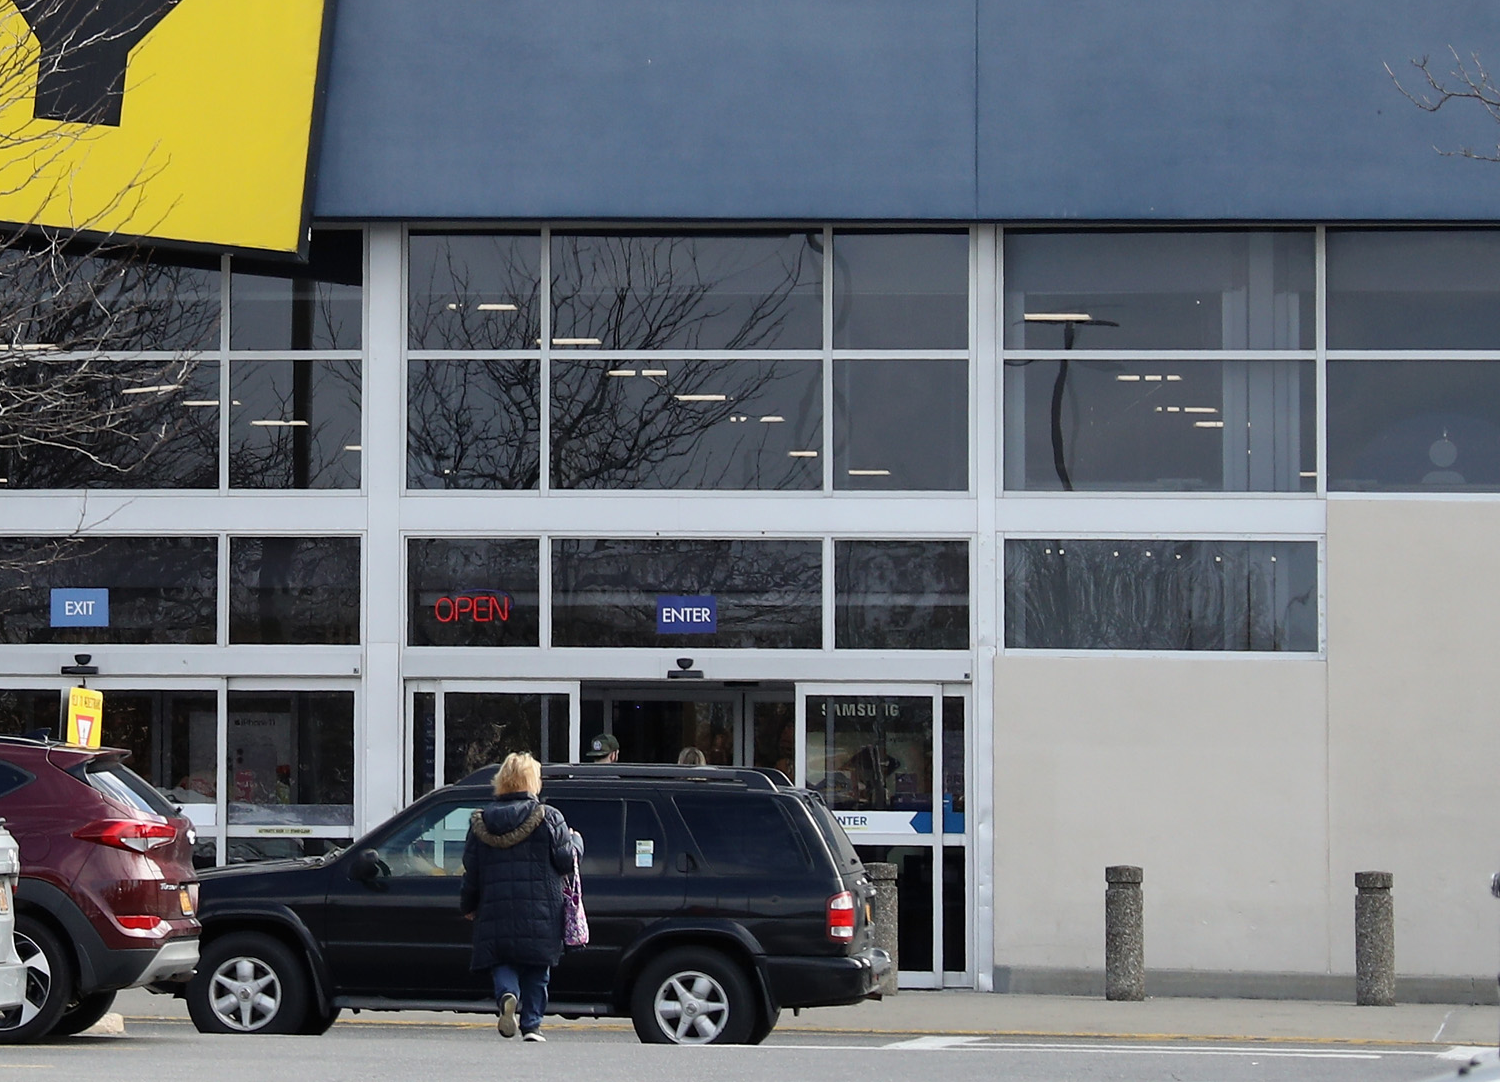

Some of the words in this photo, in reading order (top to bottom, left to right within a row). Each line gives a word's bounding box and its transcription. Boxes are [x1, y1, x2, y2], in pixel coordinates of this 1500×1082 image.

[65, 600, 96, 616] EXIT
[434, 596, 509, 622] OPEN
[662, 607, 711, 623] ENTER
[836, 816, 867, 826] NTER
